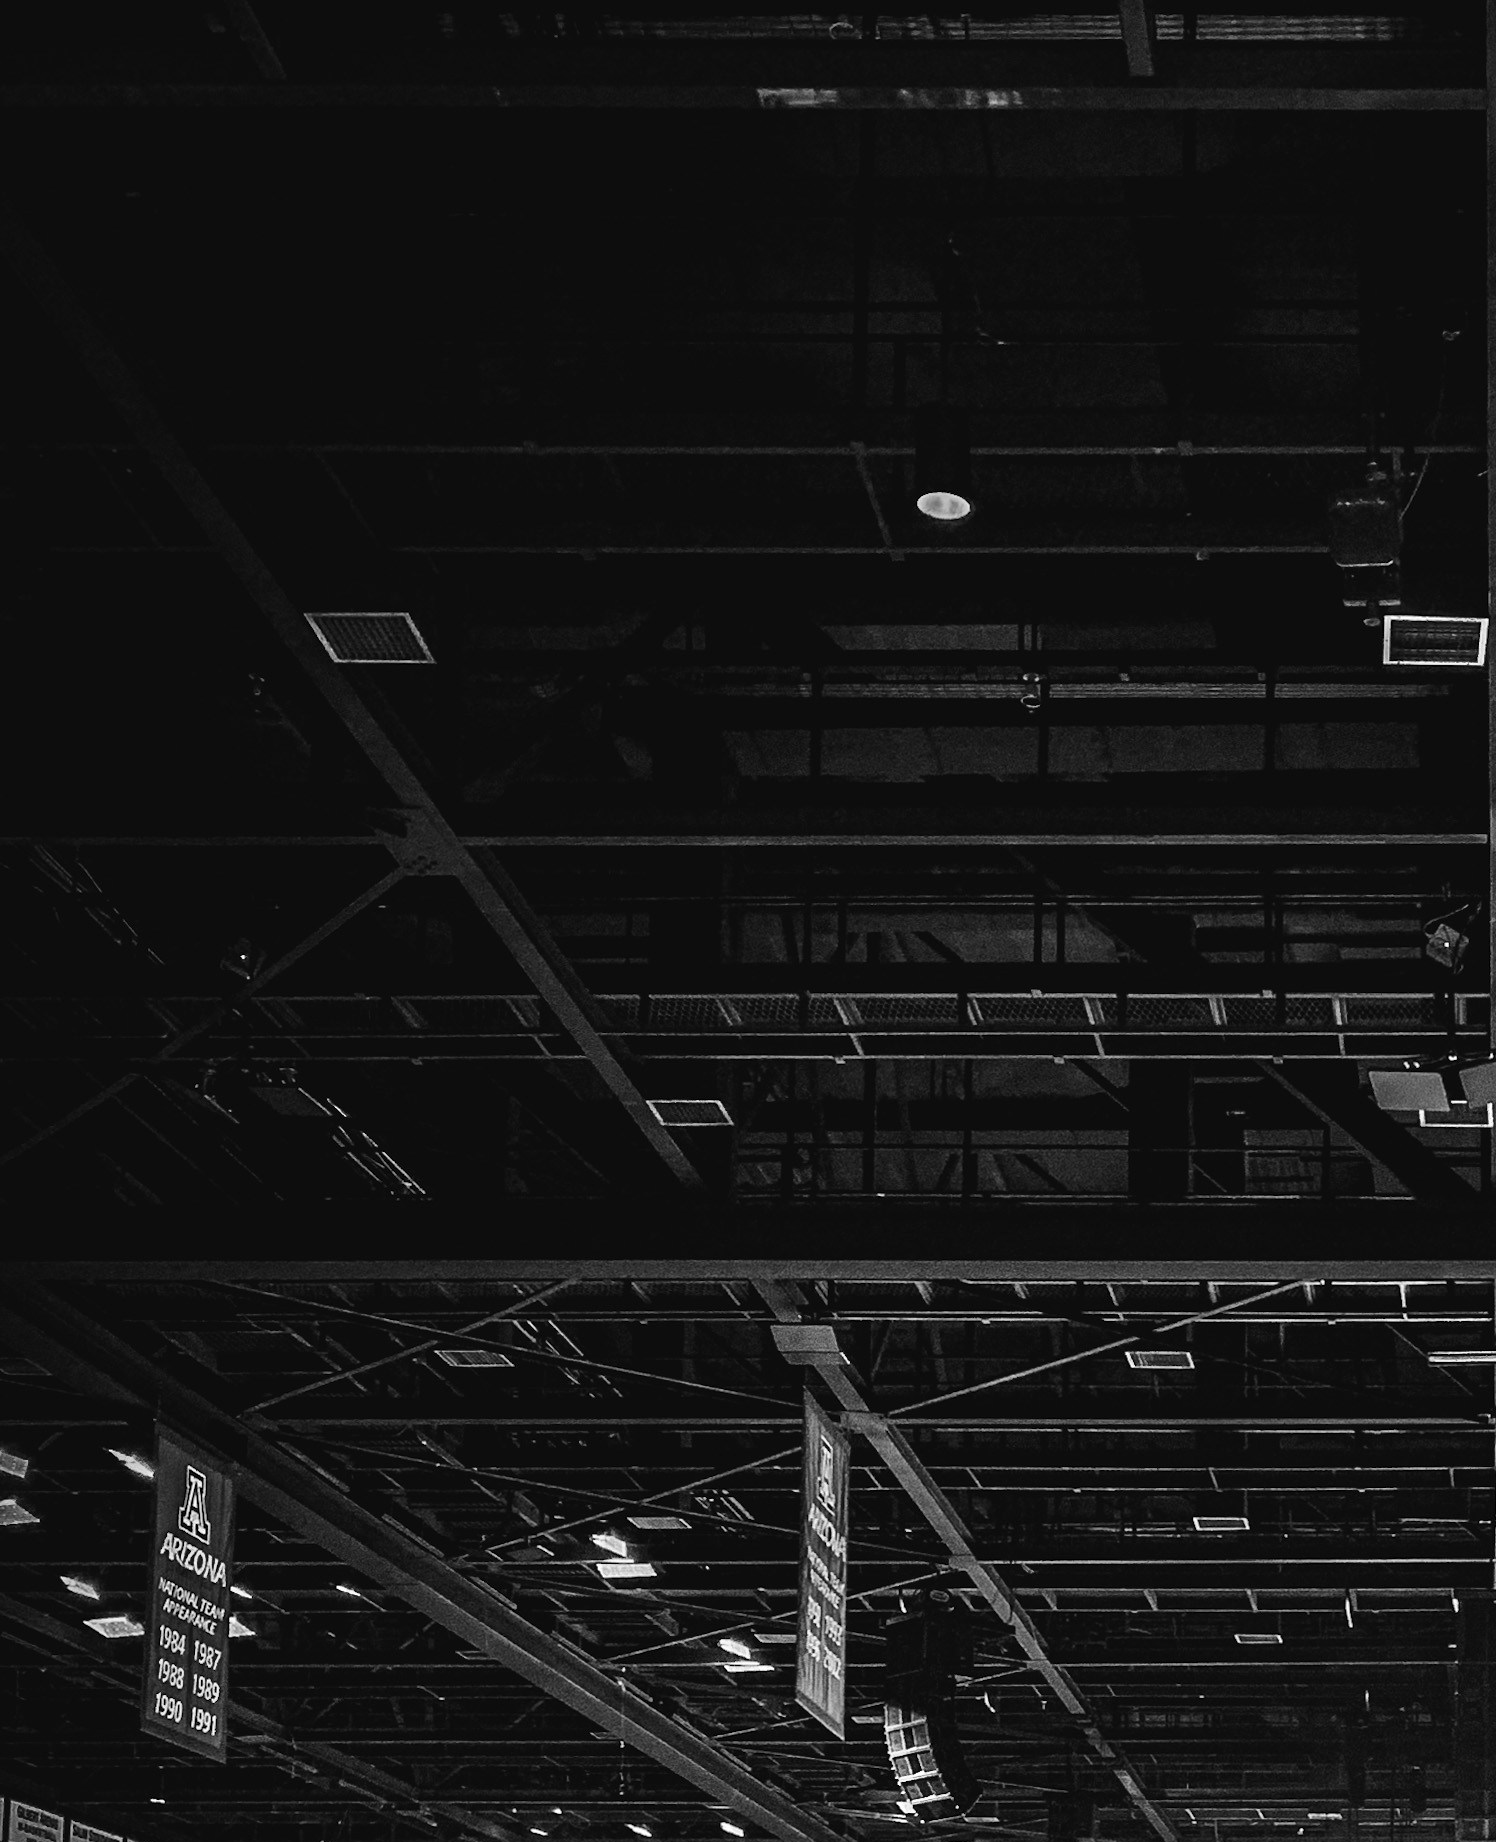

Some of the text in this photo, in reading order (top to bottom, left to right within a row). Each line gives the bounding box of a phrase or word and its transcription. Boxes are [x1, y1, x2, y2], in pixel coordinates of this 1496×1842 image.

[160, 1533, 227, 1587] ARIZONA
[158, 1577, 226, 1622] NATIONAL TEAM
[159, 1625, 222, 1671] 1984 1987
[158, 1658, 221, 1704] 1988 1989
[155, 1693, 218, 1736] 1990 1991
